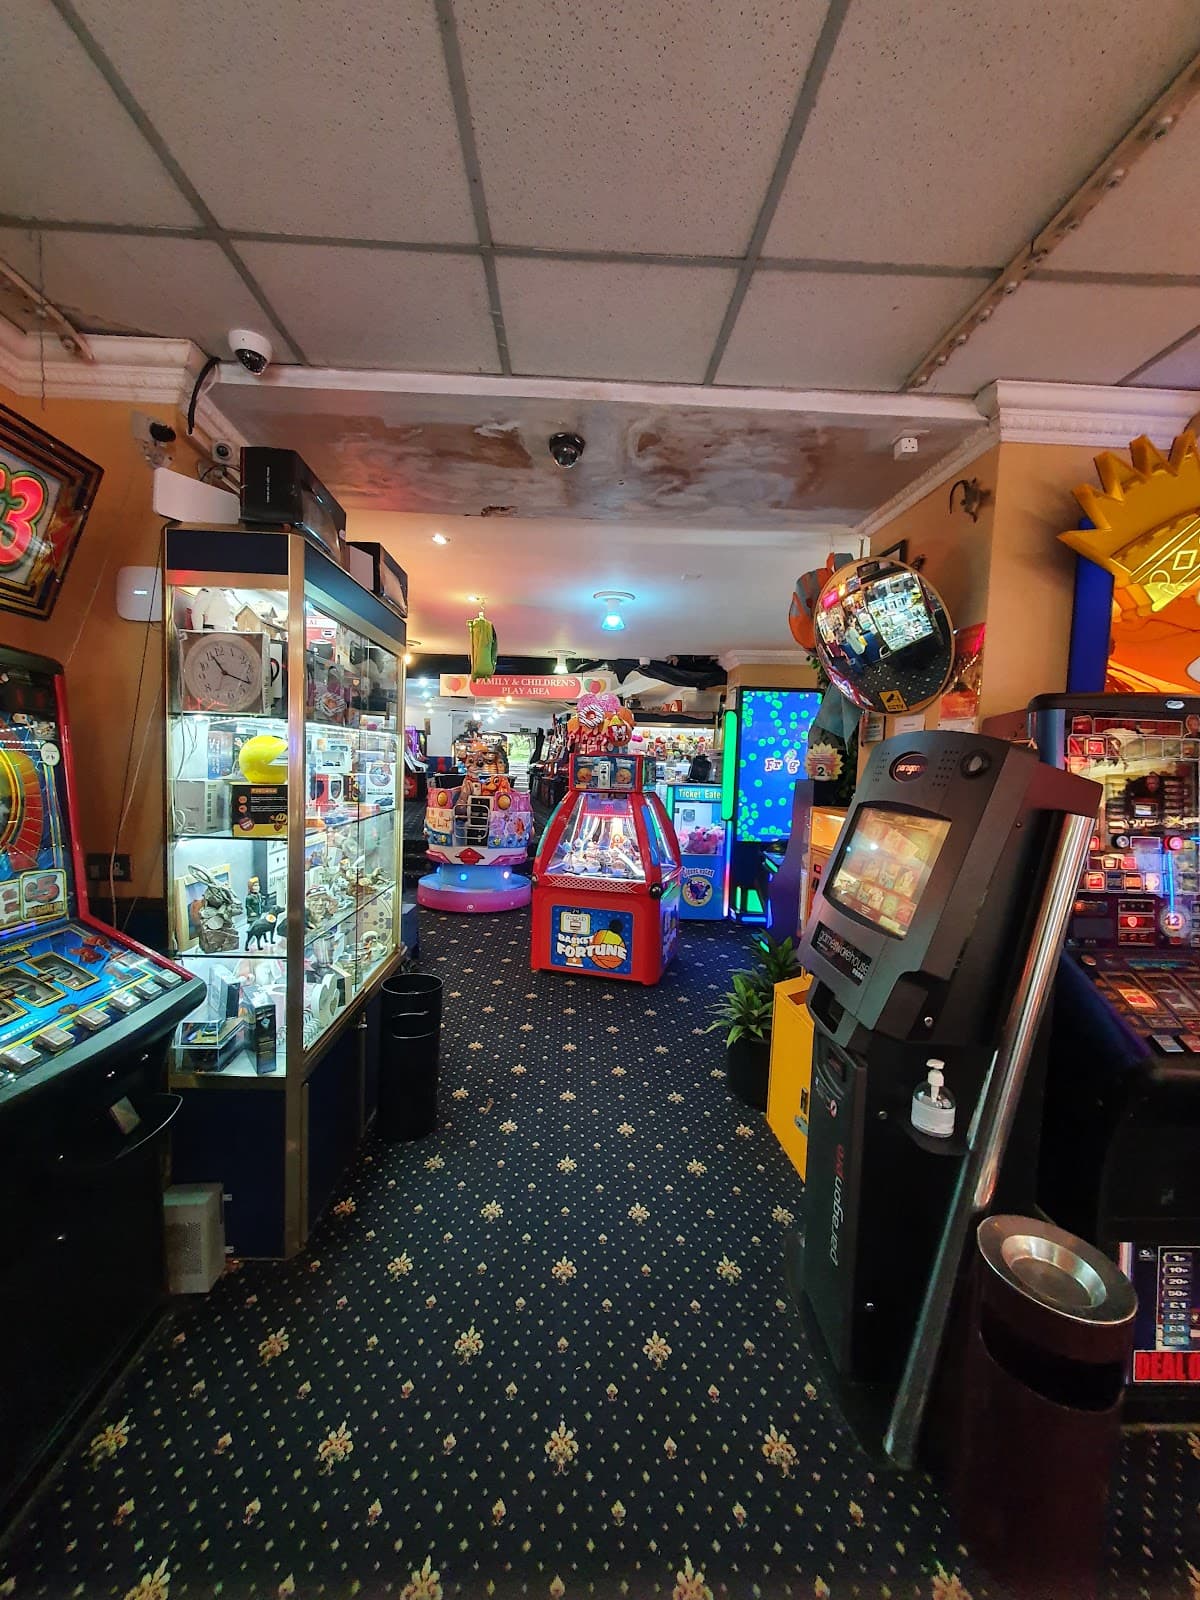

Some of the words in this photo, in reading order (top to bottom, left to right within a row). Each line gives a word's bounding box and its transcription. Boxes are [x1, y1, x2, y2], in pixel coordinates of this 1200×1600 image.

[475, 677, 508, 686] FAMILY
[512, 678, 518, 686] &
[521, 678, 576, 687] CHILDREN'S
[502, 687, 524, 695] PLAY
[527, 687, 550, 696] AREA
[679, 788, 701, 798] Ticket
[704, 789, 722, 799] Eate
[556, 942, 628, 960] FORTUNE
[1135, 1351, 1184, 1381] DEAL
